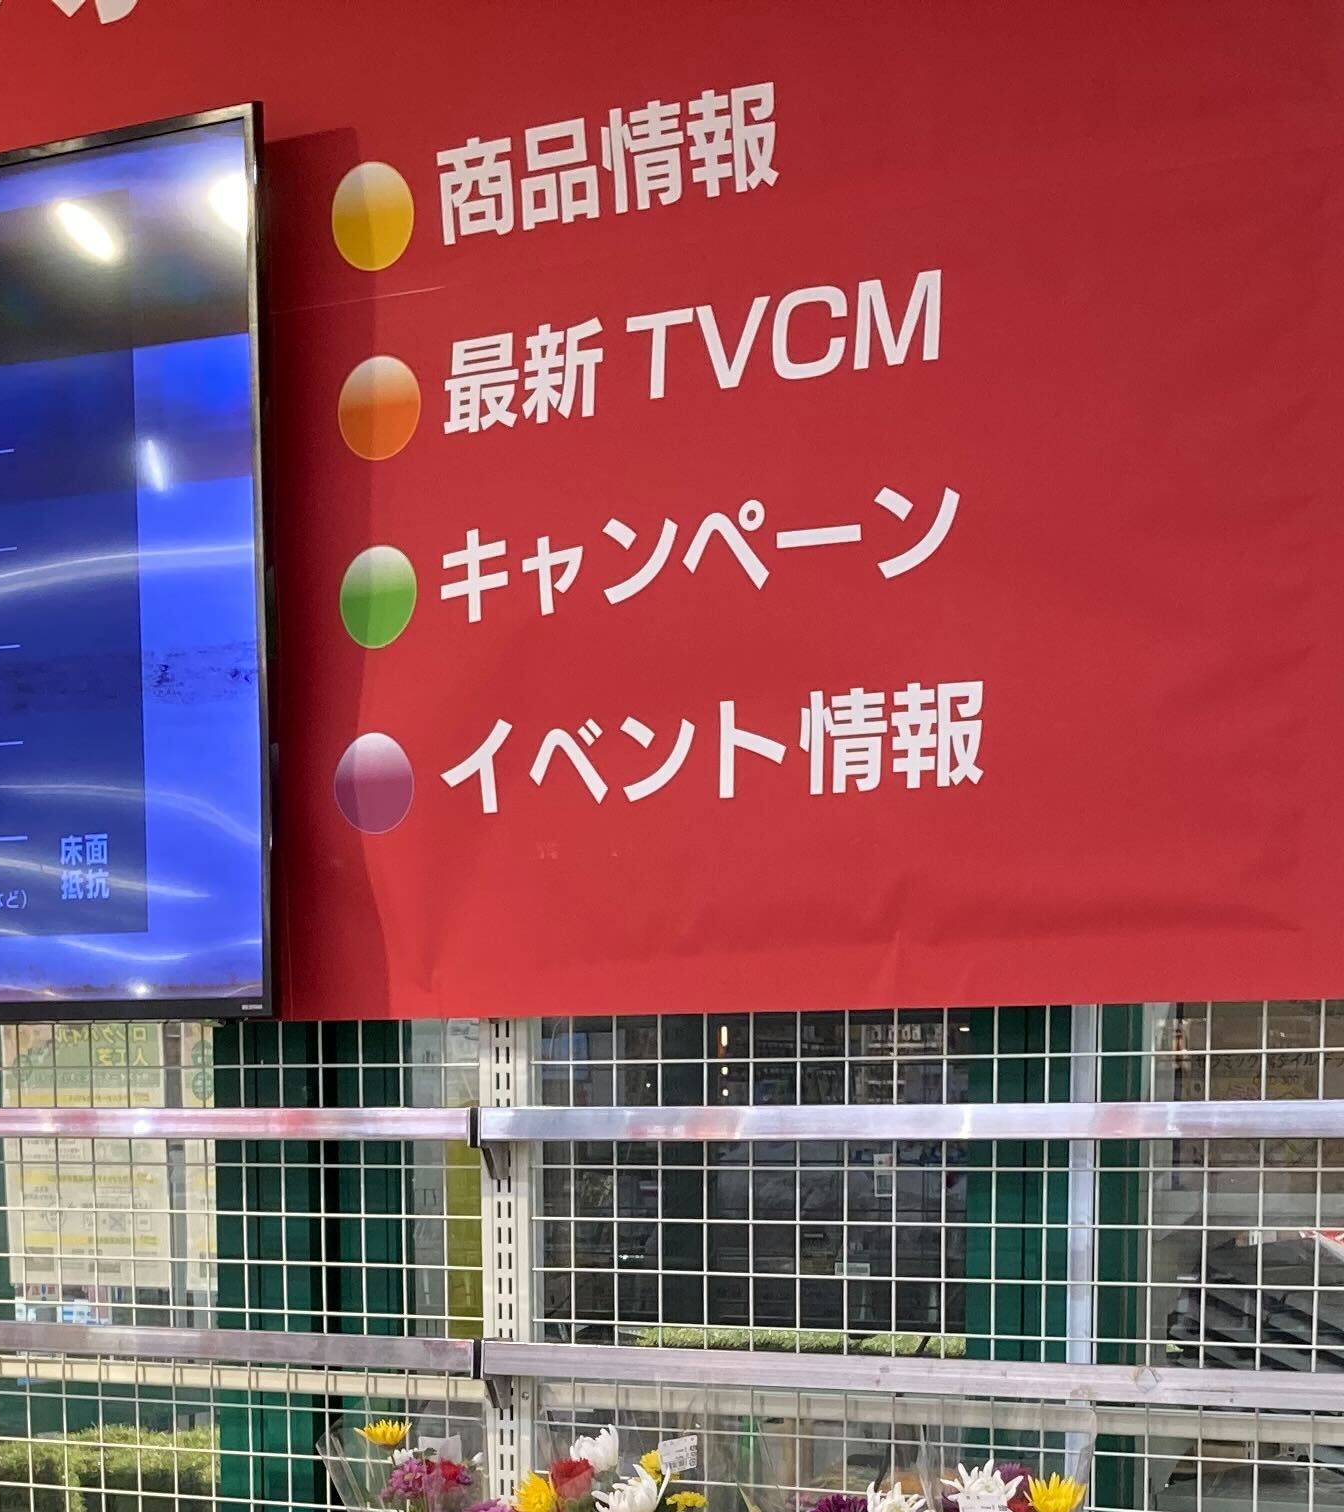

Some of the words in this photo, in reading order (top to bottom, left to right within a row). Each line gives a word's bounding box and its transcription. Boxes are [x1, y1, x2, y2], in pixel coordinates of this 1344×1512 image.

[436, 81, 779, 246] 商品情報
[442, 316, 604, 434] 最新
[625, 268, 943, 400] TVCM
[440, 486, 961, 623] キャンペーン
[440, 680, 985, 815] イベント情報
[60, 832, 109, 867] 床面
